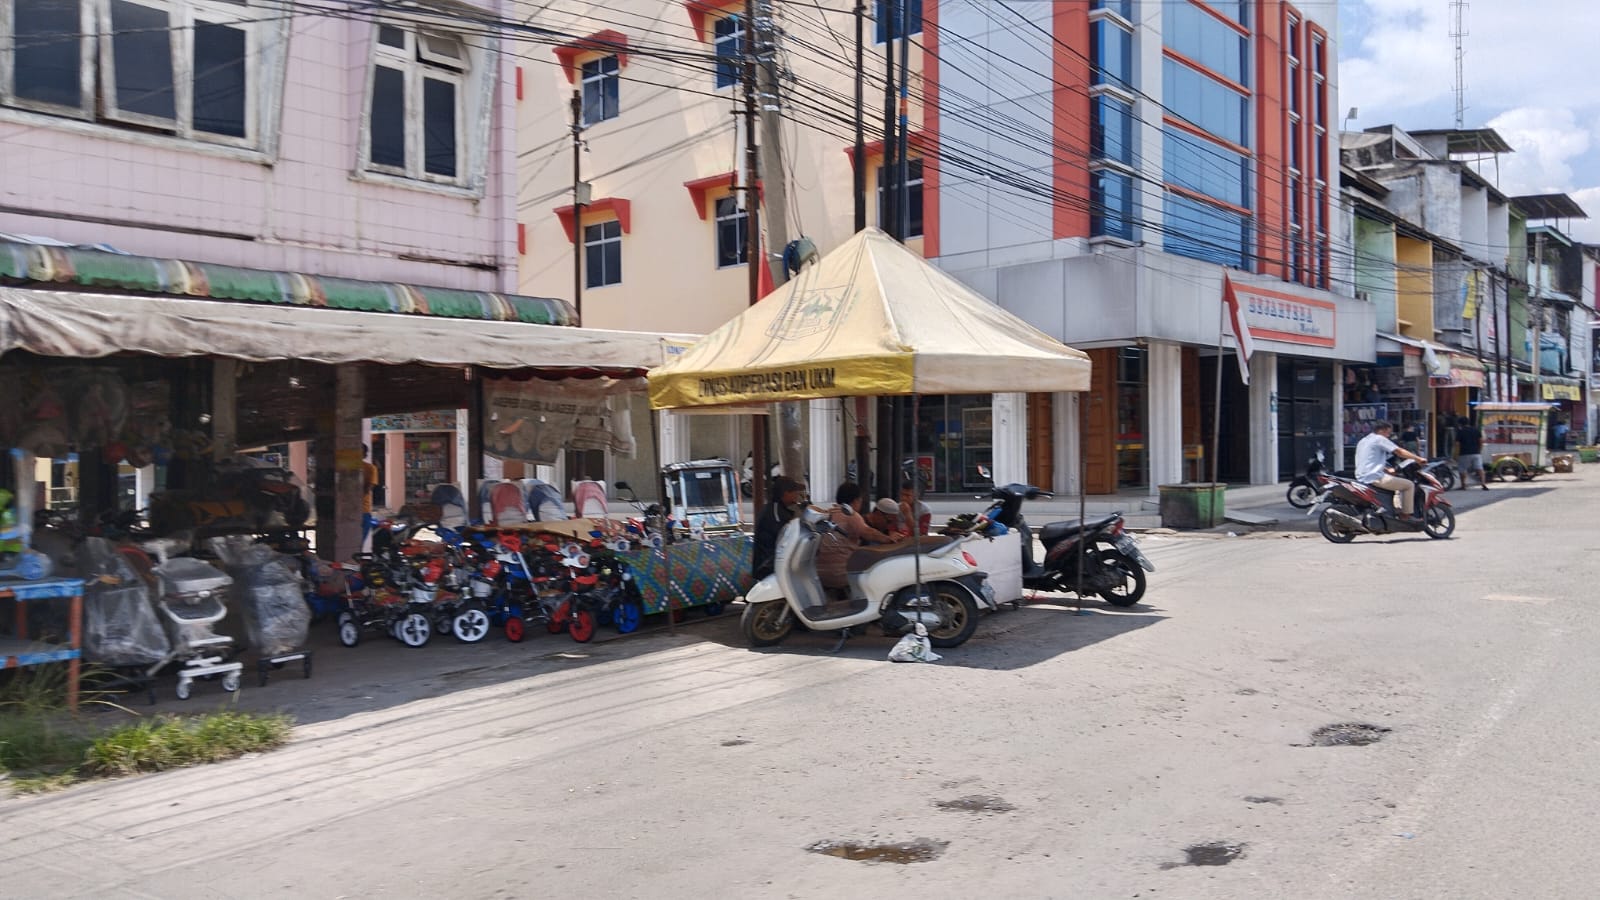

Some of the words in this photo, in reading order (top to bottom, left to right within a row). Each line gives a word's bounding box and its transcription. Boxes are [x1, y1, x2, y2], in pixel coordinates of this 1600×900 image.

[730, 371, 783, 394] KOPERASI
[784, 369, 808, 391] DAN
[809, 367, 836, 389] UKM
